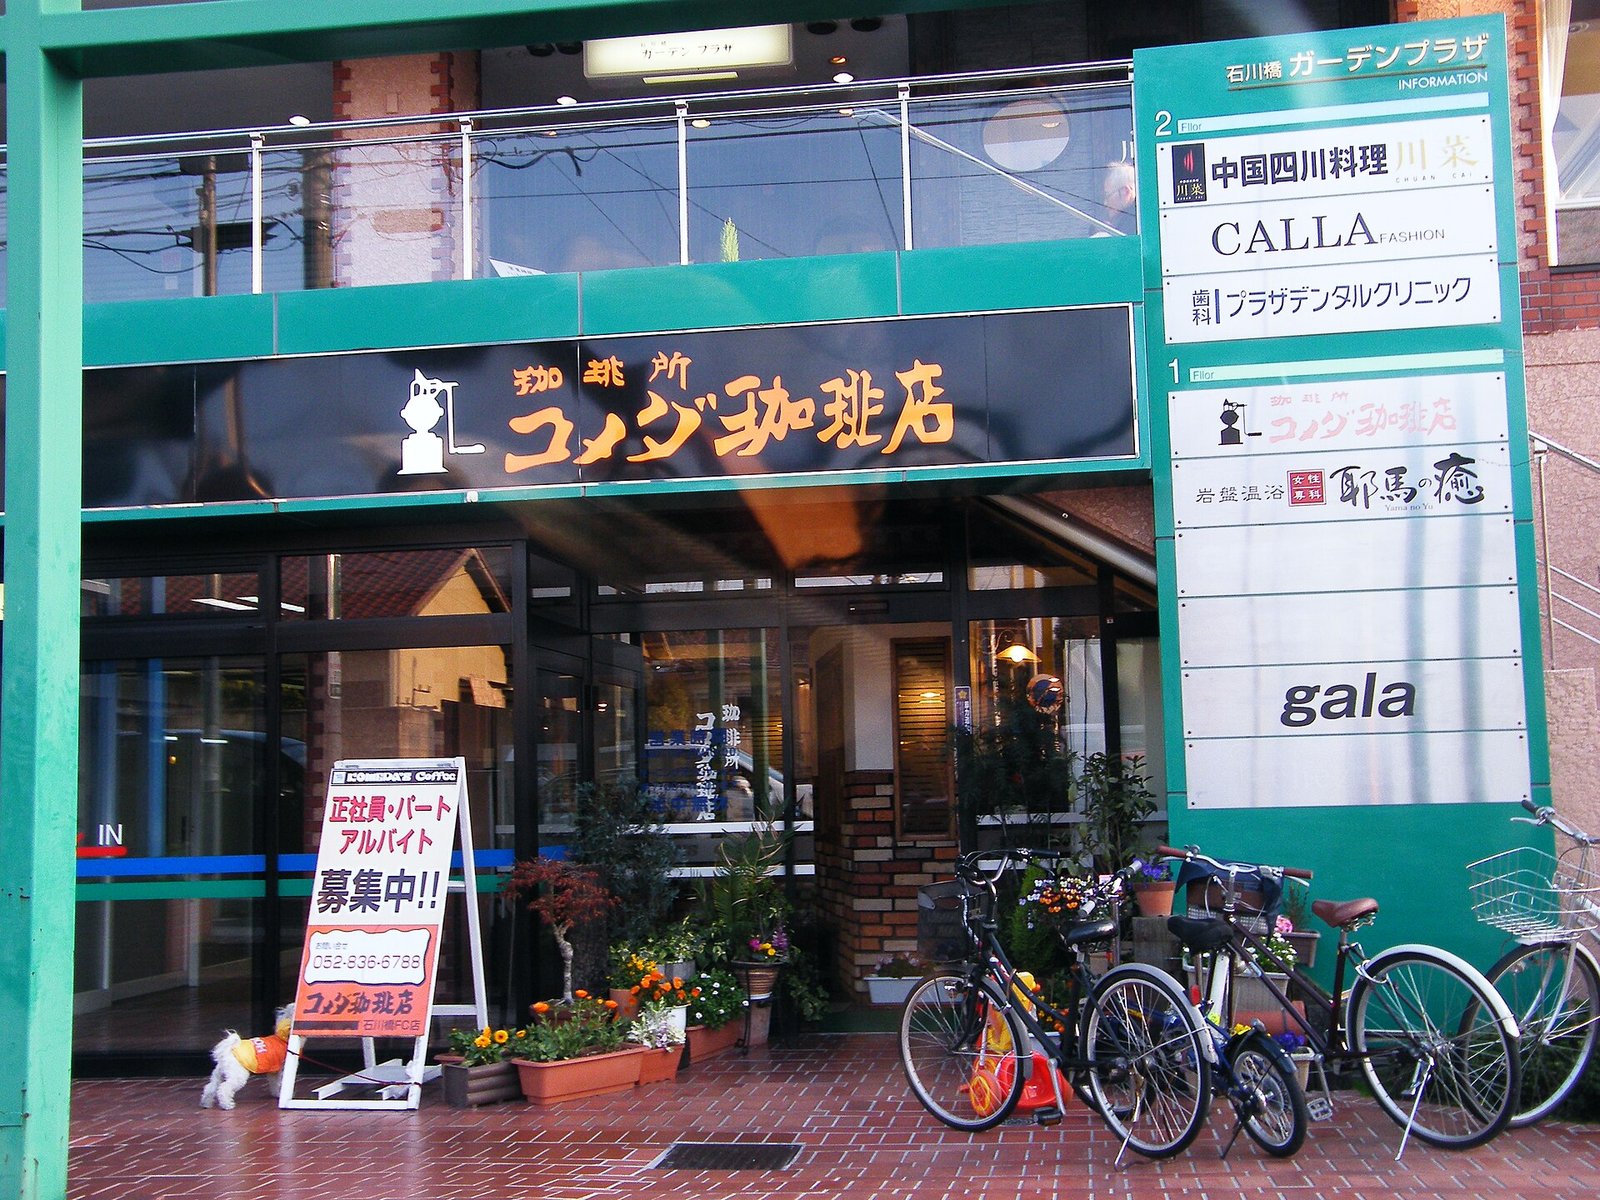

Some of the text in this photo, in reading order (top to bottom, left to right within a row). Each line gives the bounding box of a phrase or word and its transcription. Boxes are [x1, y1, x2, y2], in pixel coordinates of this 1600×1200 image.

[1226, 32, 1490, 84] 石川橋 ガーデンプラザ
[1397, 70, 1489, 92] INFORMATION
[1155, 110, 1172, 137] 2
[1211, 134, 1479, 189] 中国四川料理 川菜
[1395, 171, 1473, 184] CHUAN CAI
[1211, 212, 1446, 257] CALLA FASHION
[1192, 289, 1212, 326] 歯科
[1226, 276, 1472, 319] プラザデンタルクリニック
[512, 350, 693, 397] 珈琲所
[1168, 358, 1180, 384] 1
[504, 358, 955, 475] コメダ珈琲店
[1269, 396, 1457, 443] コメダ珈琲店
[1195, 452, 1485, 509] 岩盤温浴 耶馬の癒
[1292, 473, 1320, 485] 女性
[1385, 503, 1408, 512] Yama
[1280, 672, 1417, 728] gala
[415, 771, 457, 782] Coffee
[329, 795, 451, 823] 正社員・パート
[98, 823, 123, 846] IN
[339, 828, 433, 855] アルバイト
[317, 868, 440, 914] 募集中!!
[312, 954, 421, 969] 052-836-6788
[302, 988, 414, 1016] コメダ珈琲店
